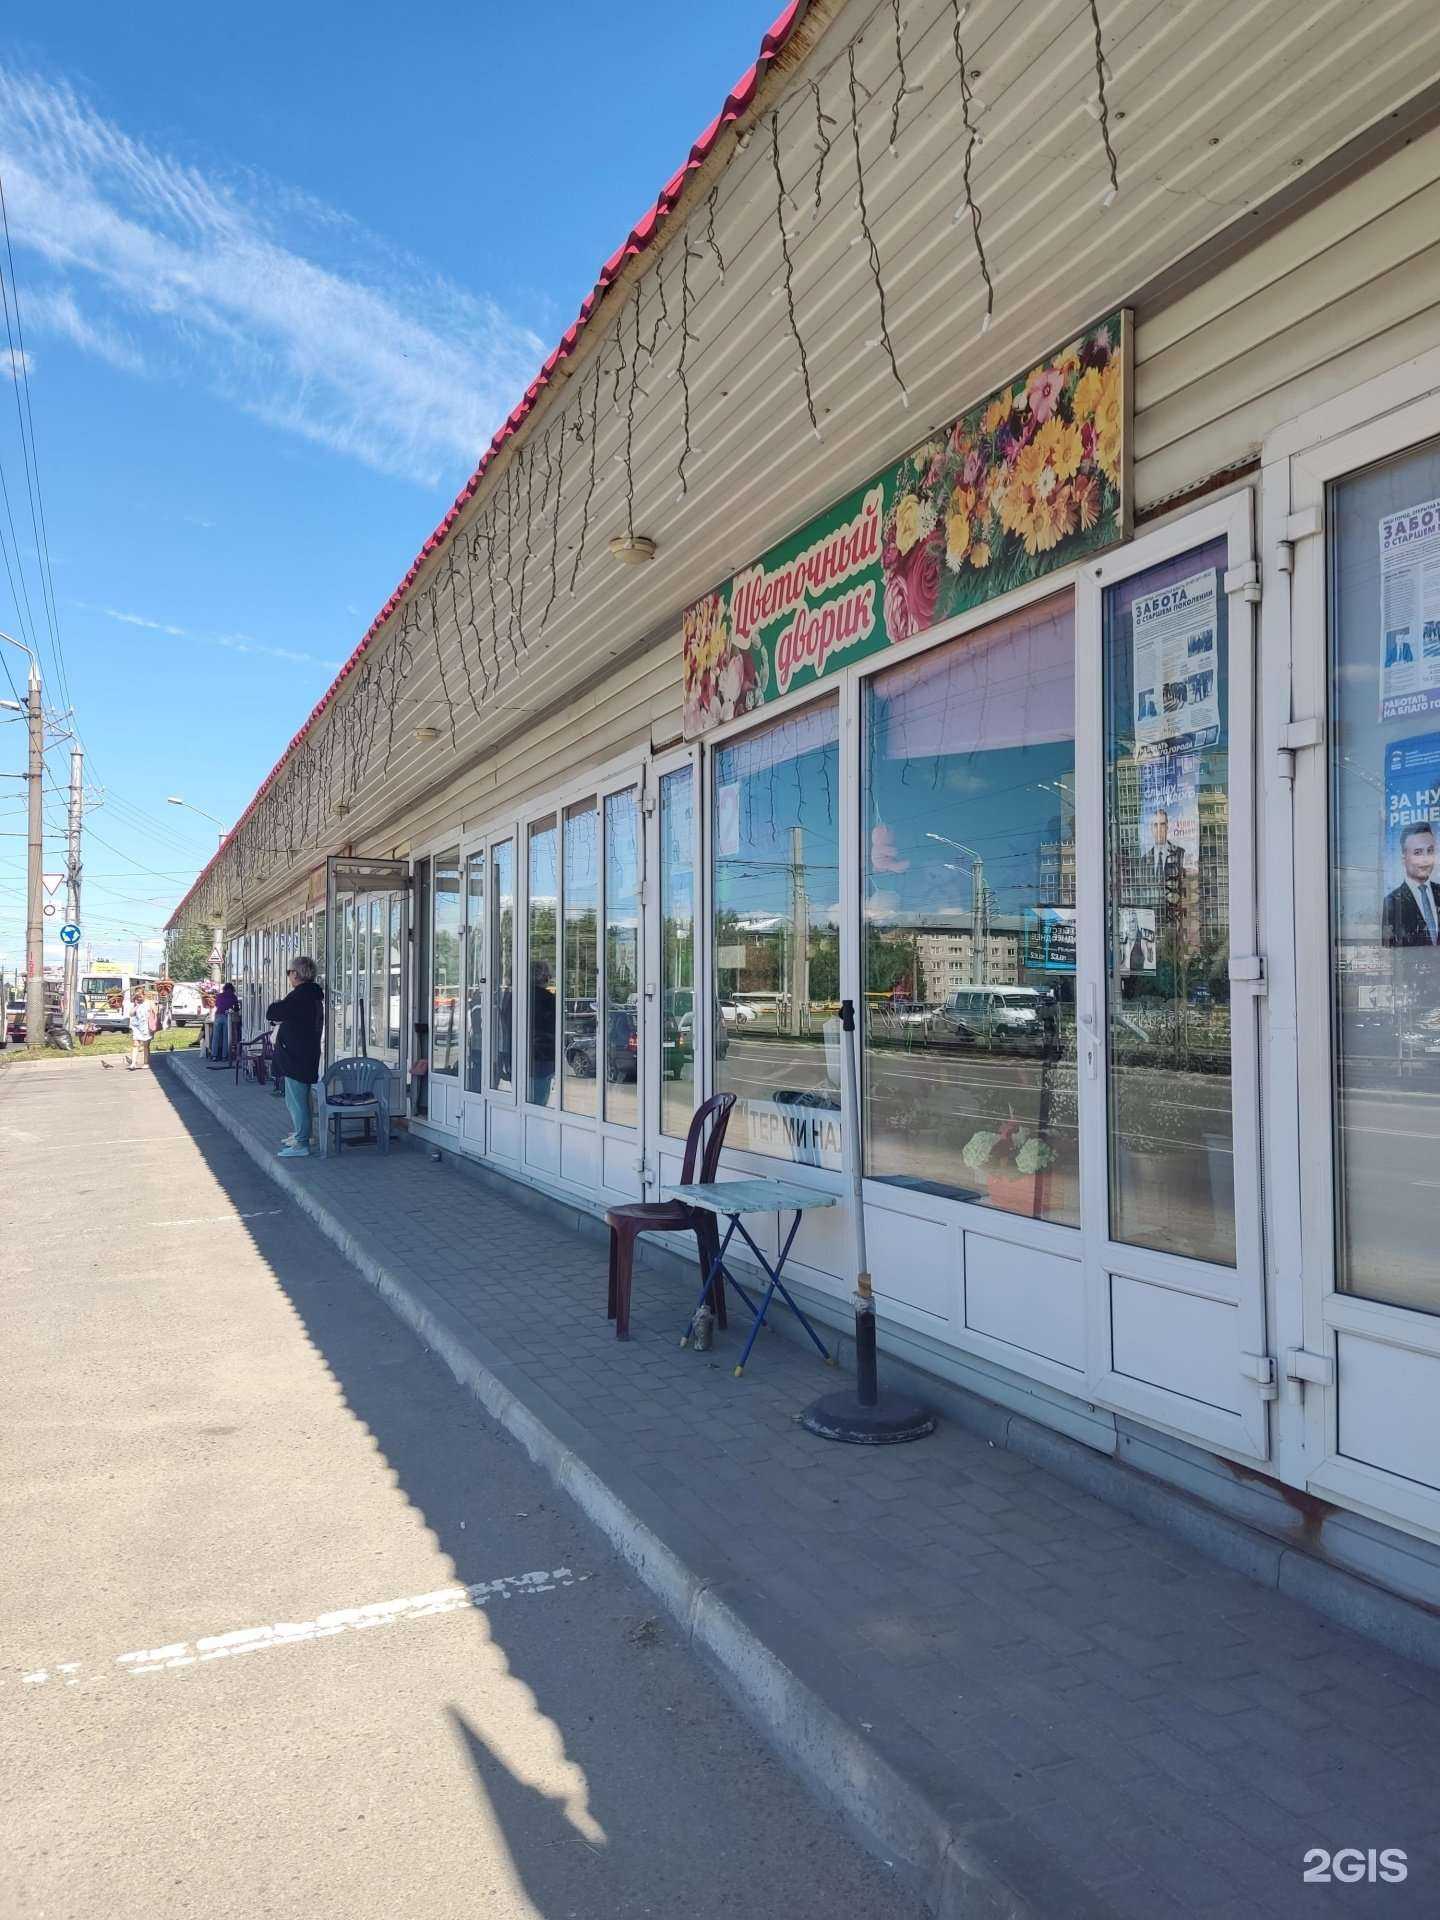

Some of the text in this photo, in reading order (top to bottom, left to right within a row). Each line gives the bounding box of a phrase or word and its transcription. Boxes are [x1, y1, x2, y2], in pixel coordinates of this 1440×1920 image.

[733, 497, 879, 639] Цветочный
[1135, 588, 1188, 618] ЗАБОТА
[1173, 588, 1214, 612] ПОКОЛЕНИИ
[777, 587, 872, 687] дворик
[1398, 701, 1429, 715] БЛАГО
[1390, 787, 1440, 811] ЗА НУ
[1390, 806, 1440, 828] РЕШЕ
